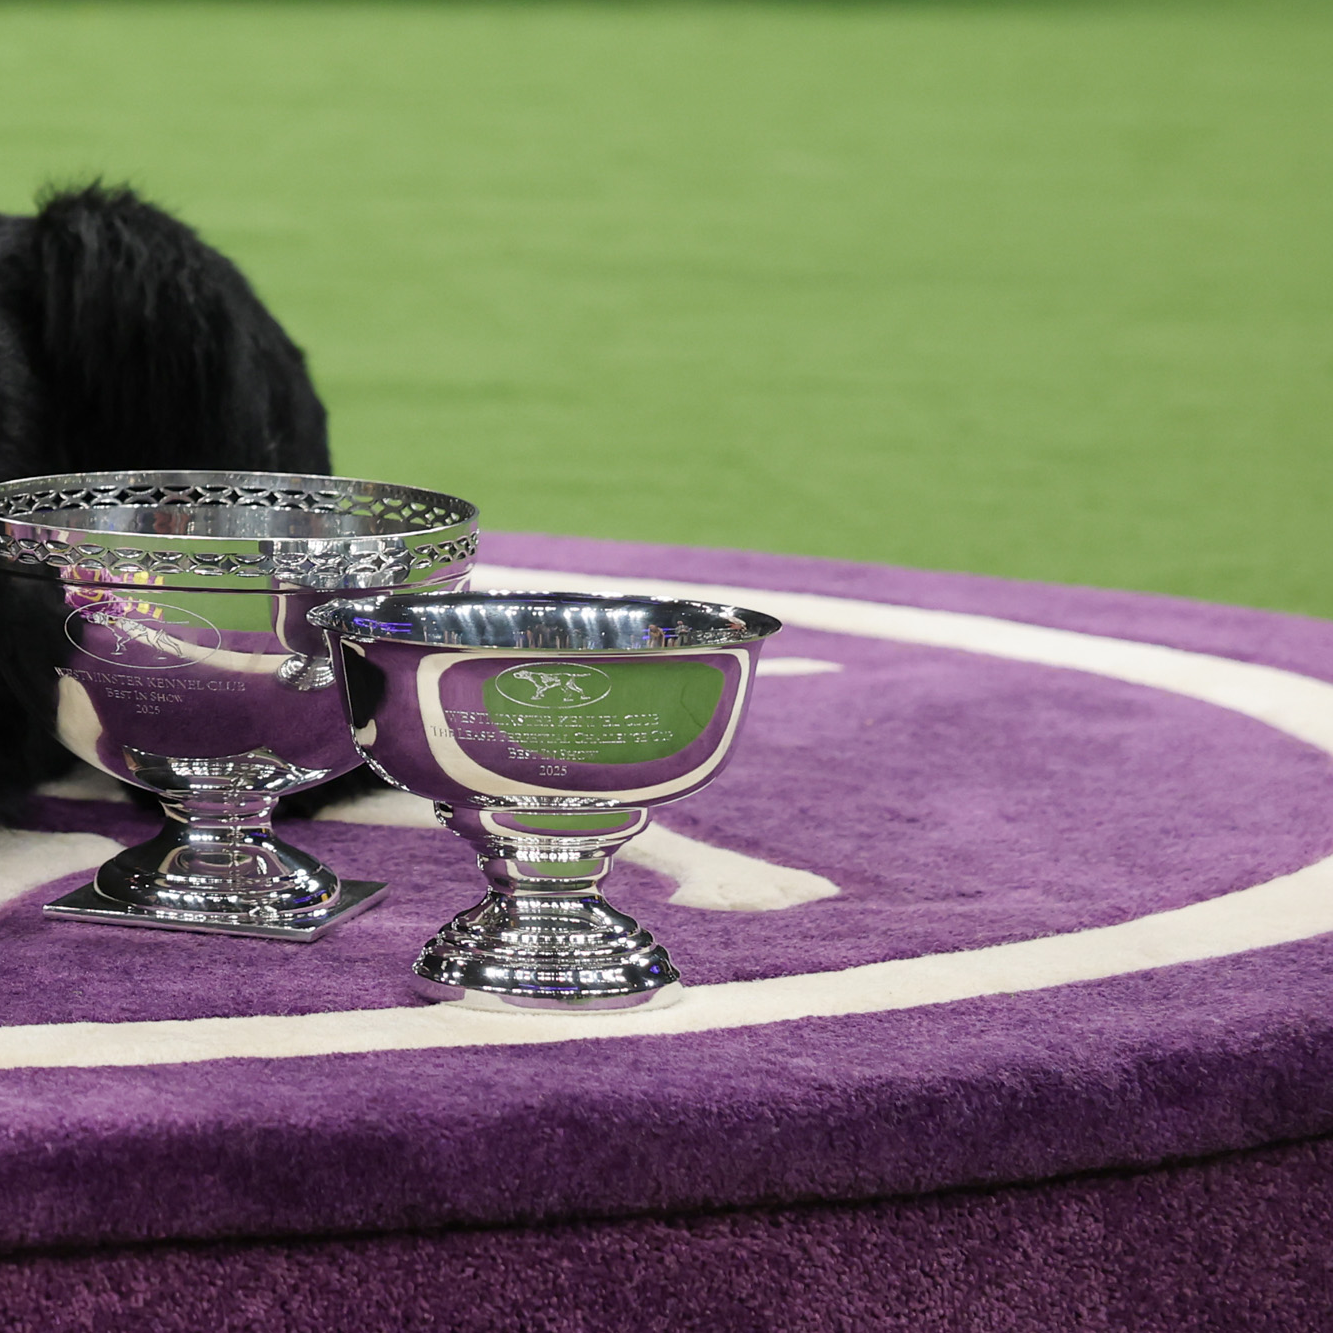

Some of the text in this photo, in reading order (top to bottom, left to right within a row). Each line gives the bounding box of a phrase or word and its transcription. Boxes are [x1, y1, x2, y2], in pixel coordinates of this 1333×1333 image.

[147, 676, 204, 690] KENNEL
[207, 680, 246, 692] CLUB
[105, 687, 132, 699] BEST
[150, 691, 183, 703] SHOW
[539, 764, 568, 777] 2025
